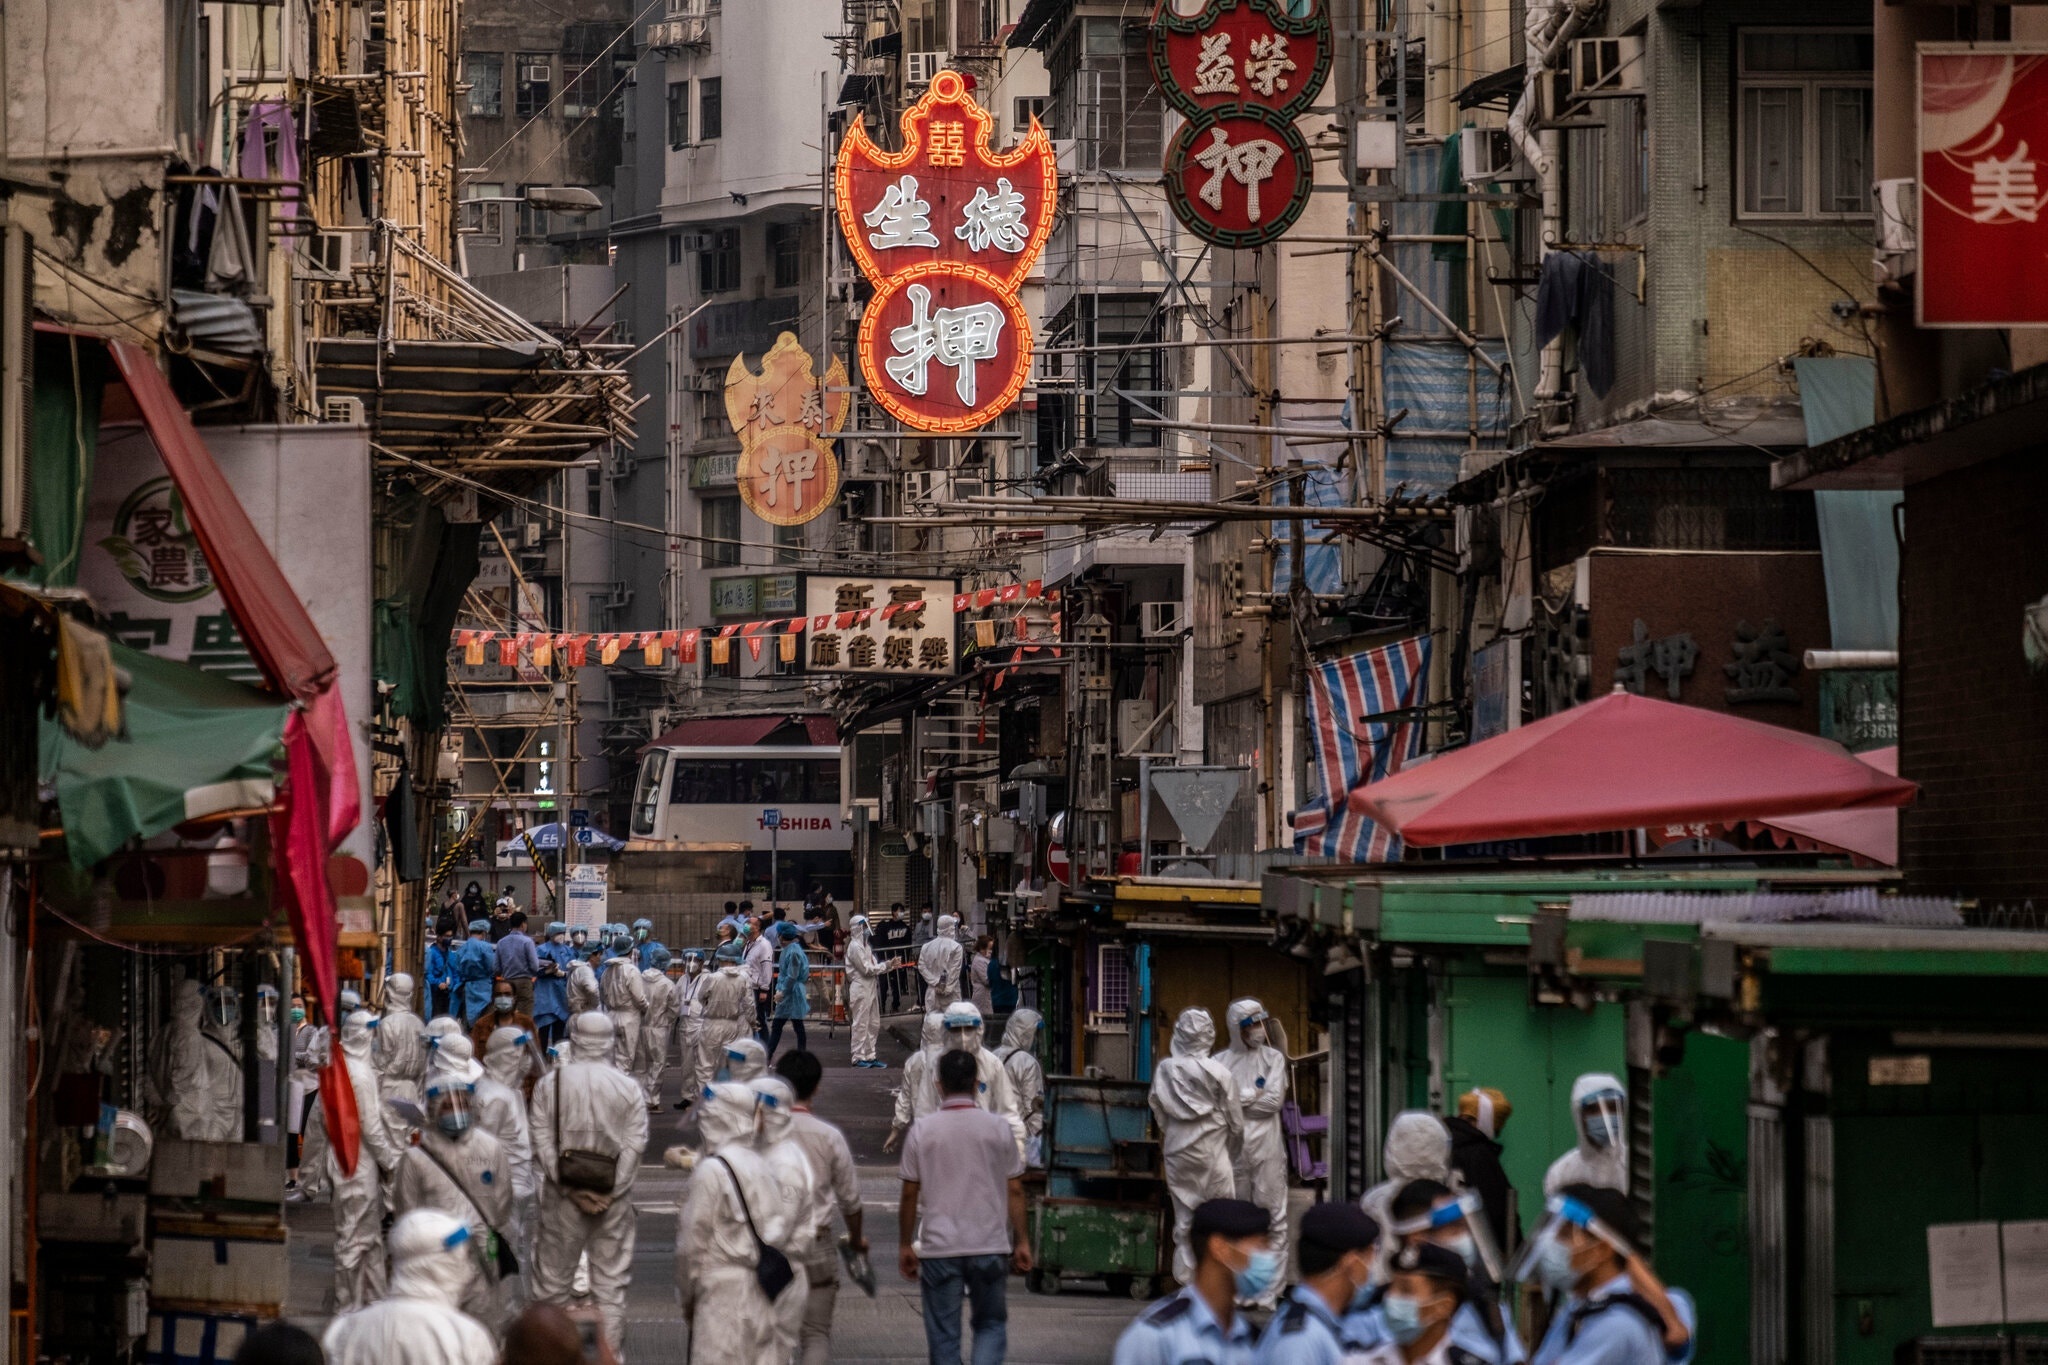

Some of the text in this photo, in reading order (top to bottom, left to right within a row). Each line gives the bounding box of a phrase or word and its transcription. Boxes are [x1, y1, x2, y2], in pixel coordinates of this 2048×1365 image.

[1195, 127, 1285, 223] 押
[1966, 138, 2039, 223] 美
[885, 284, 1005, 407] 押
[760, 446, 819, 512] 押
[835, 583, 926, 630] 新豪
[757, 817, 832, 830] TSHIBA
